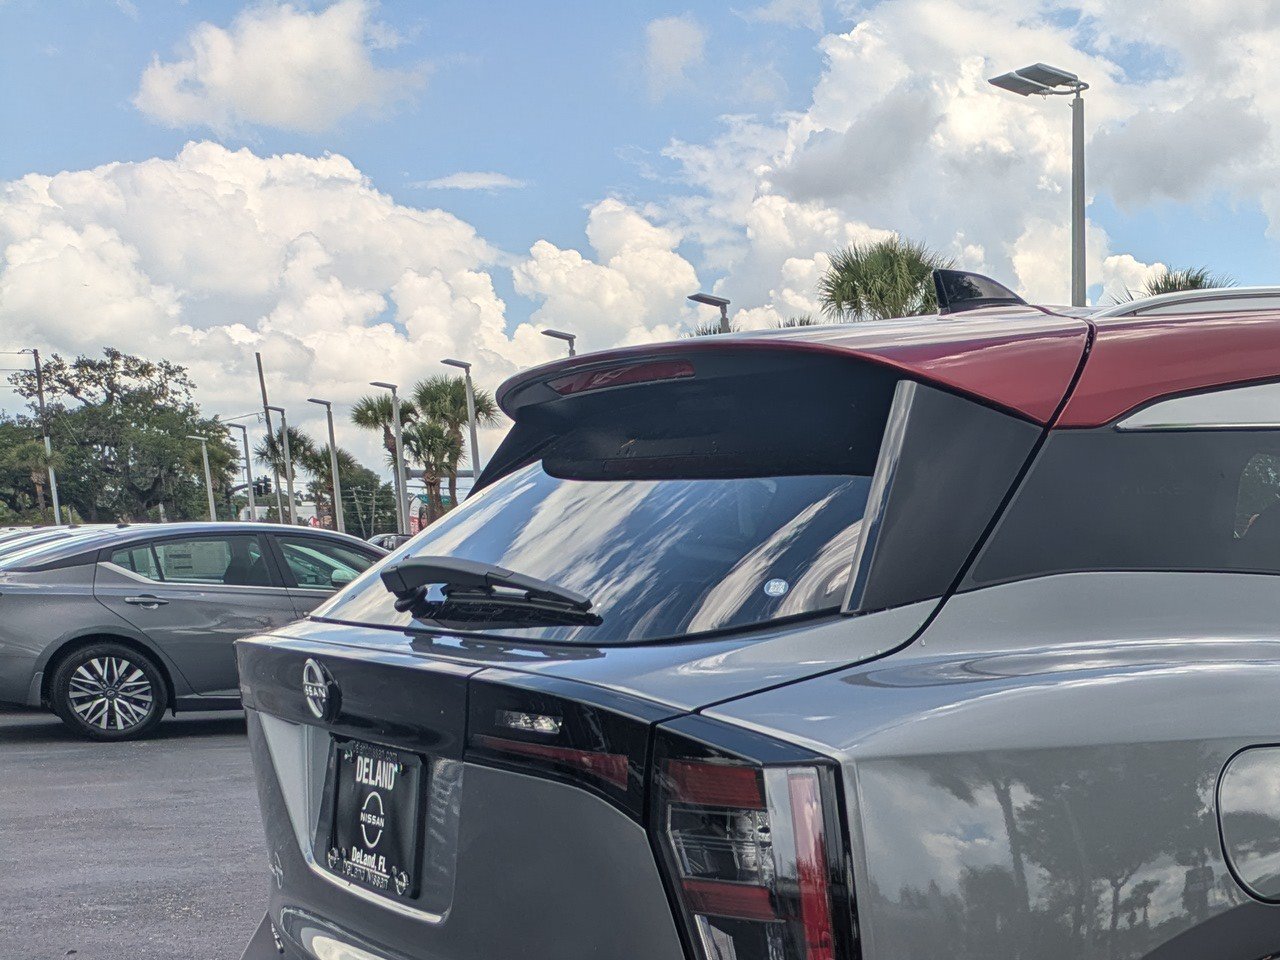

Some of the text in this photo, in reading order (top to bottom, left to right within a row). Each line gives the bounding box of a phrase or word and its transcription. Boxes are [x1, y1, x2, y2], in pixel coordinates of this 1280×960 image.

[356, 757, 395, 790] DELAND
[360, 812, 385, 828] NISSAN
[351, 846, 377, 871] DeLand,
[378, 855, 387, 873] FL
